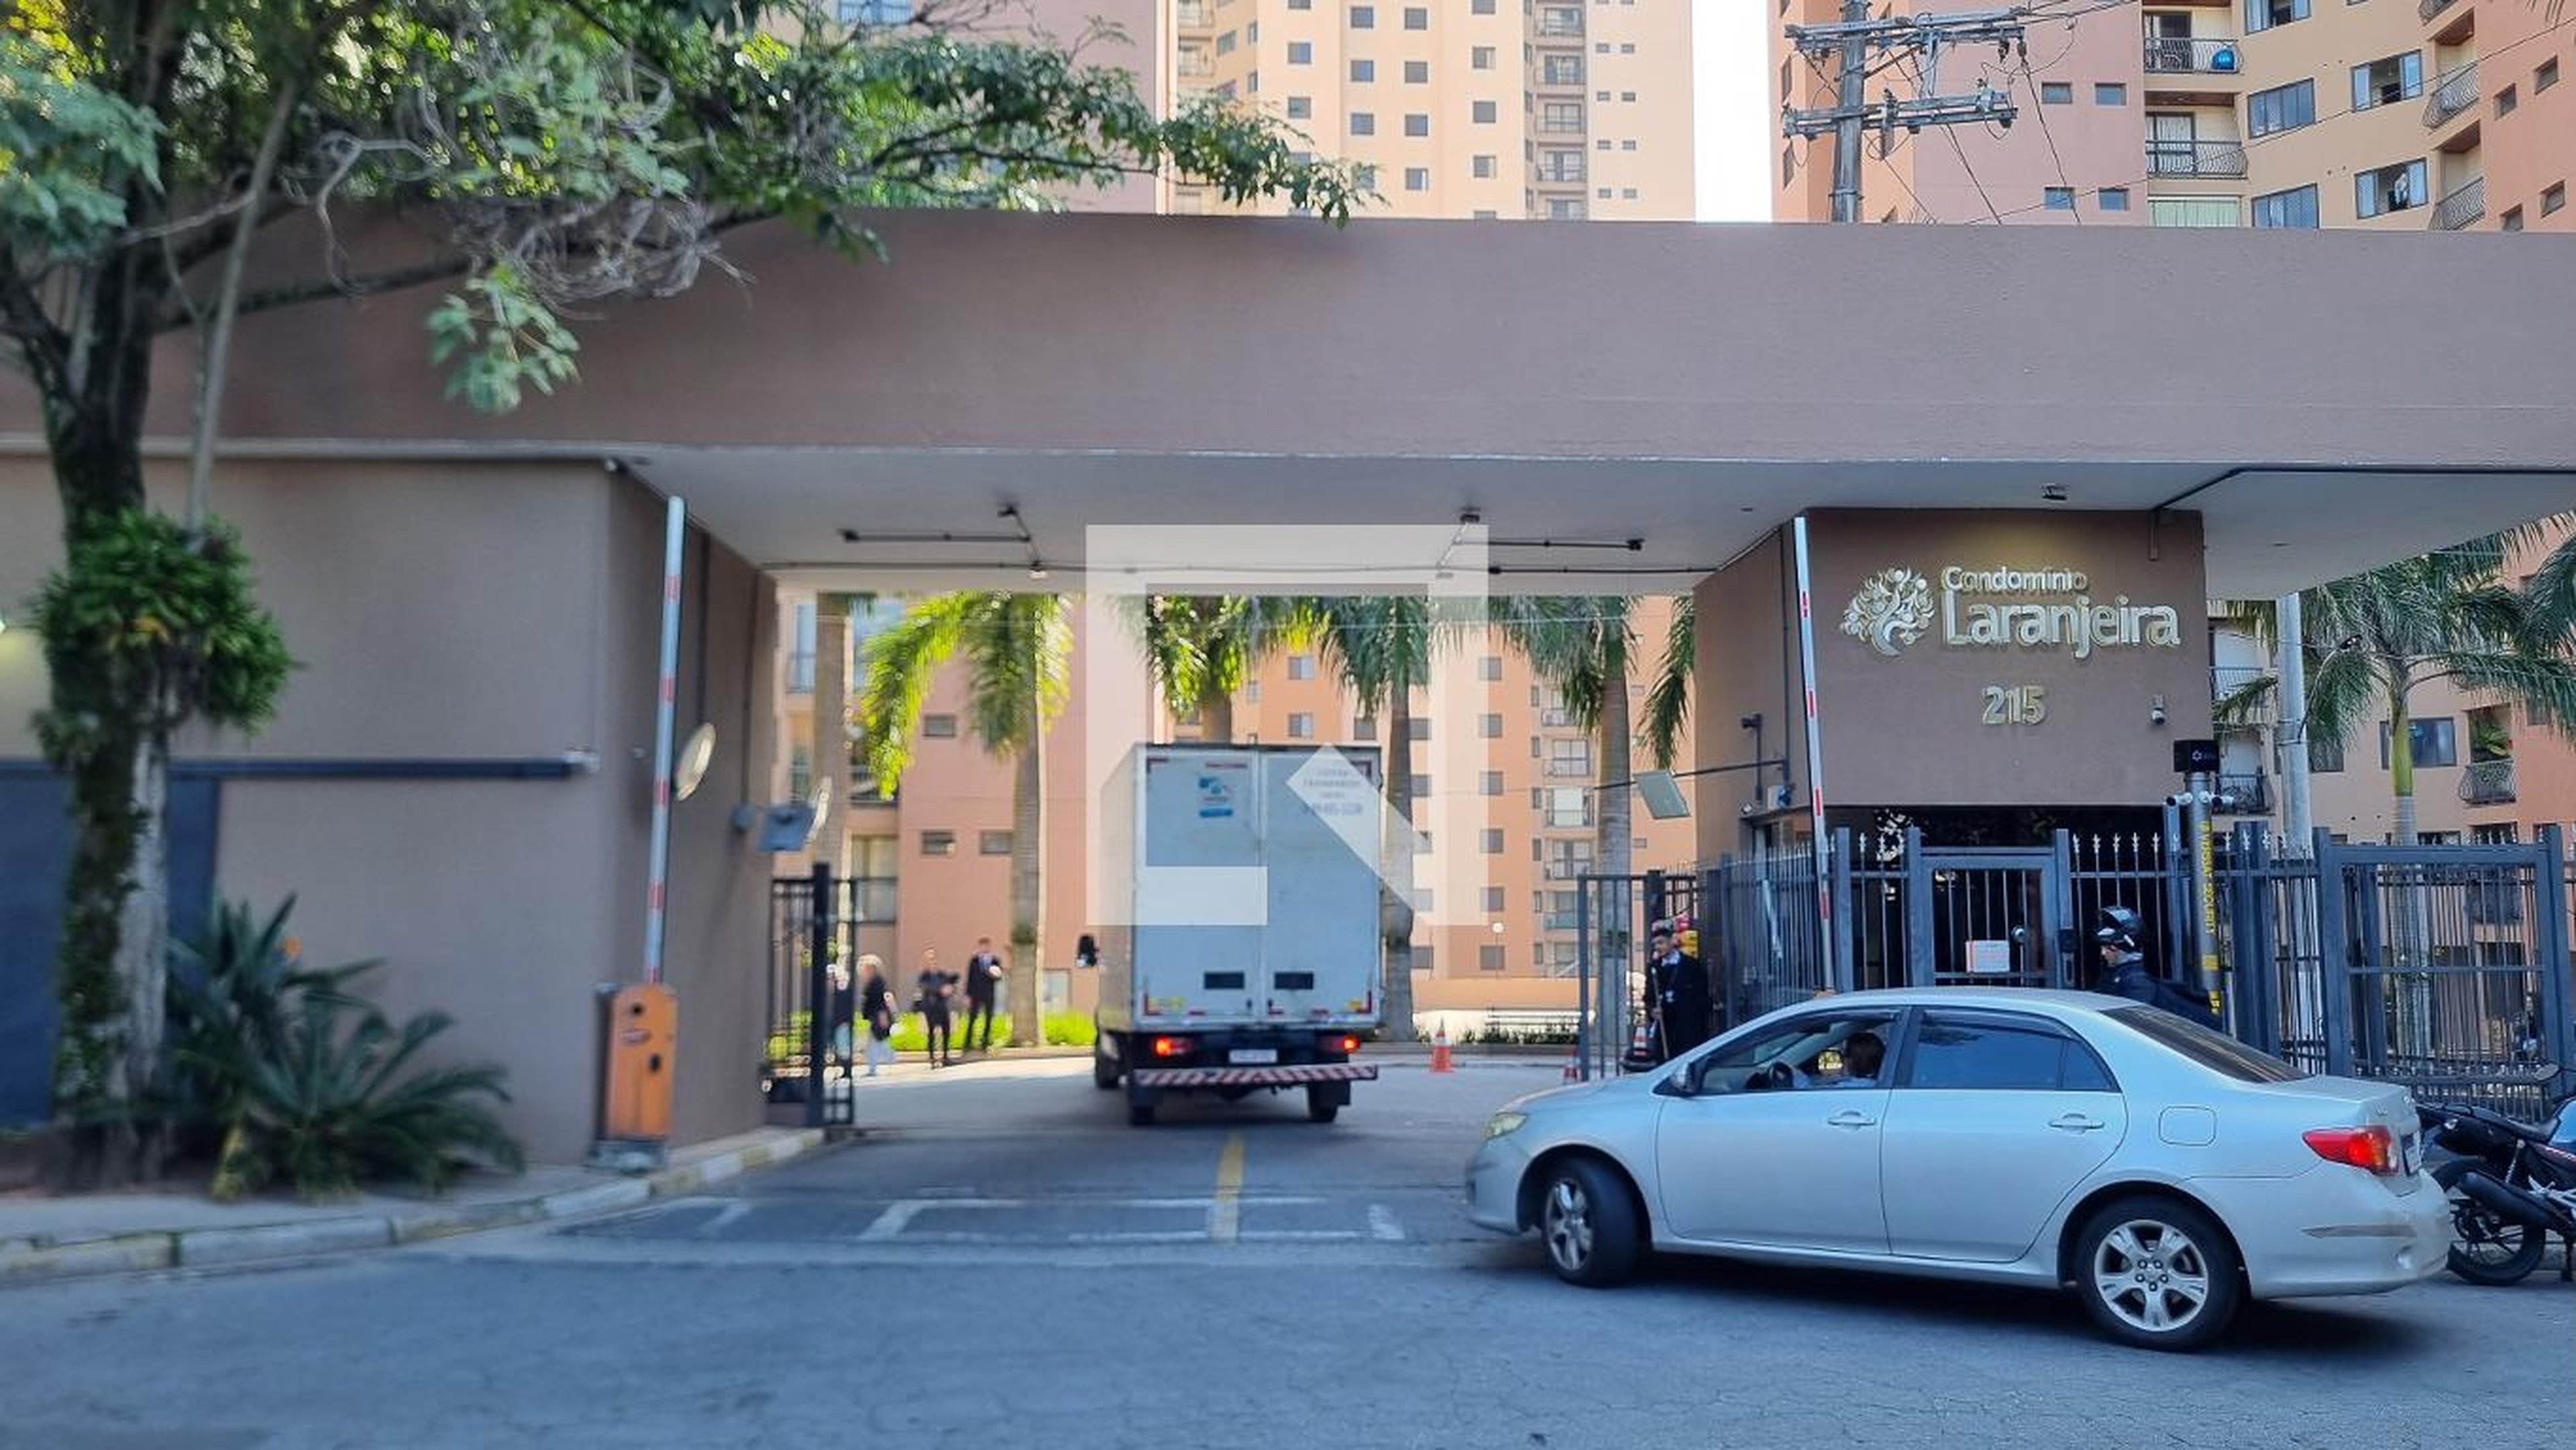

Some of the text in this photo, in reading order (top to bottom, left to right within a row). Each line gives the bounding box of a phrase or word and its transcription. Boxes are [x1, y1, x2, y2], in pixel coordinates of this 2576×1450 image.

[1941, 565, 2088, 594] Condomínio
[1942, 588, 2180, 659] Laranjeira
[1982, 685, 2047, 726] 215
